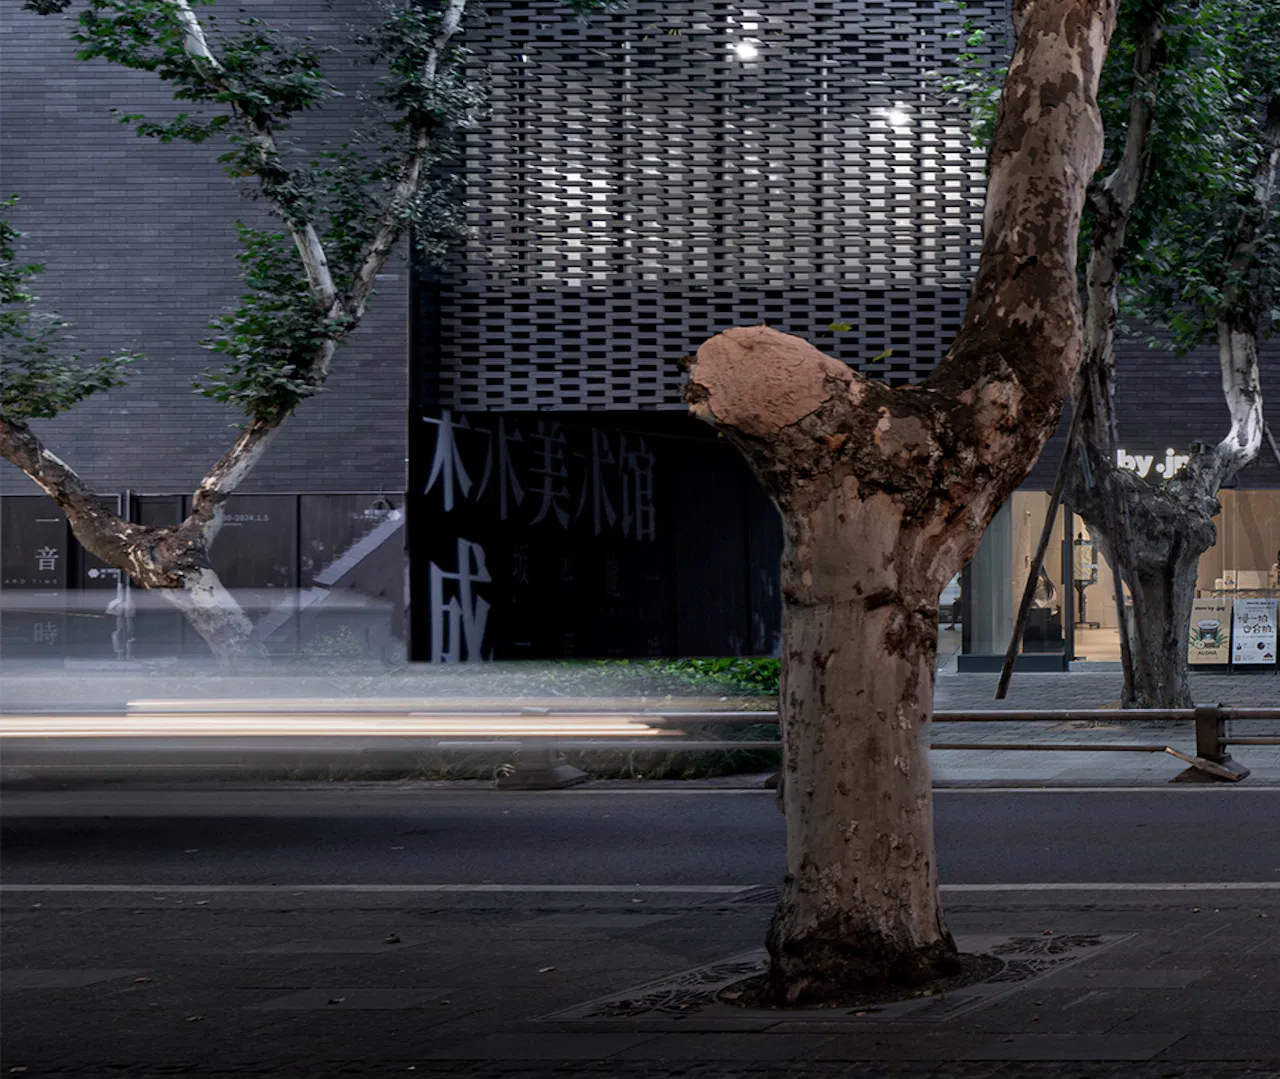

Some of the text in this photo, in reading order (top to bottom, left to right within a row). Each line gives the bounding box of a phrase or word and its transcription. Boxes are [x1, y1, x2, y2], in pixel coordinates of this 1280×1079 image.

[421, 408, 657, 542] 木木美术馆
[1116, 447, 1190, 479] by .jp
